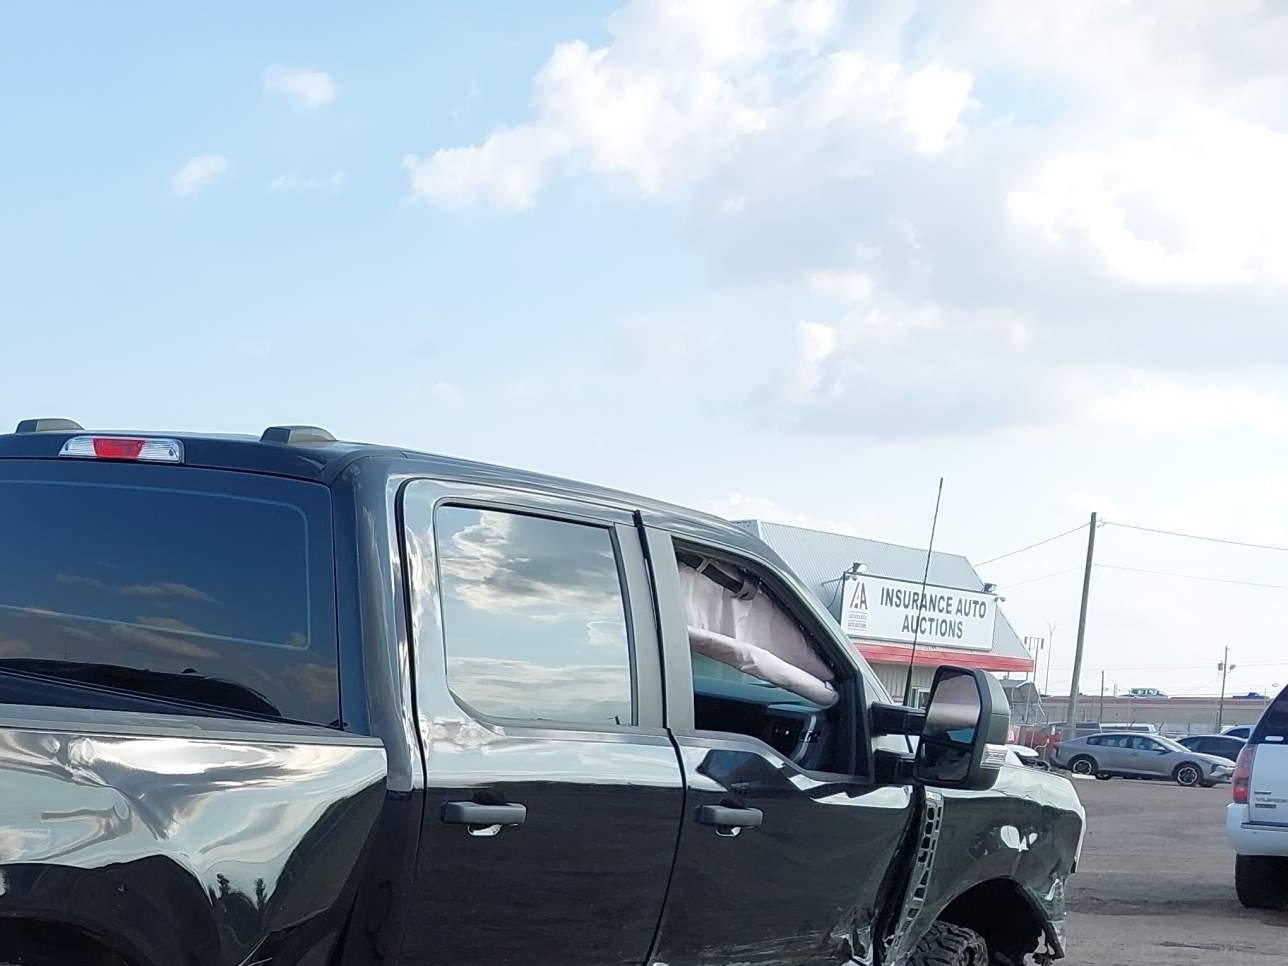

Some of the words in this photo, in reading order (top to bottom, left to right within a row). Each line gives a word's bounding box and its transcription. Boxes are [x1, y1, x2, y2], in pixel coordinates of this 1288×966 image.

[880, 587, 953, 614] INSURANCE
[955, 598, 987, 618] AUTO
[901, 614, 963, 639] AUCTIONS
